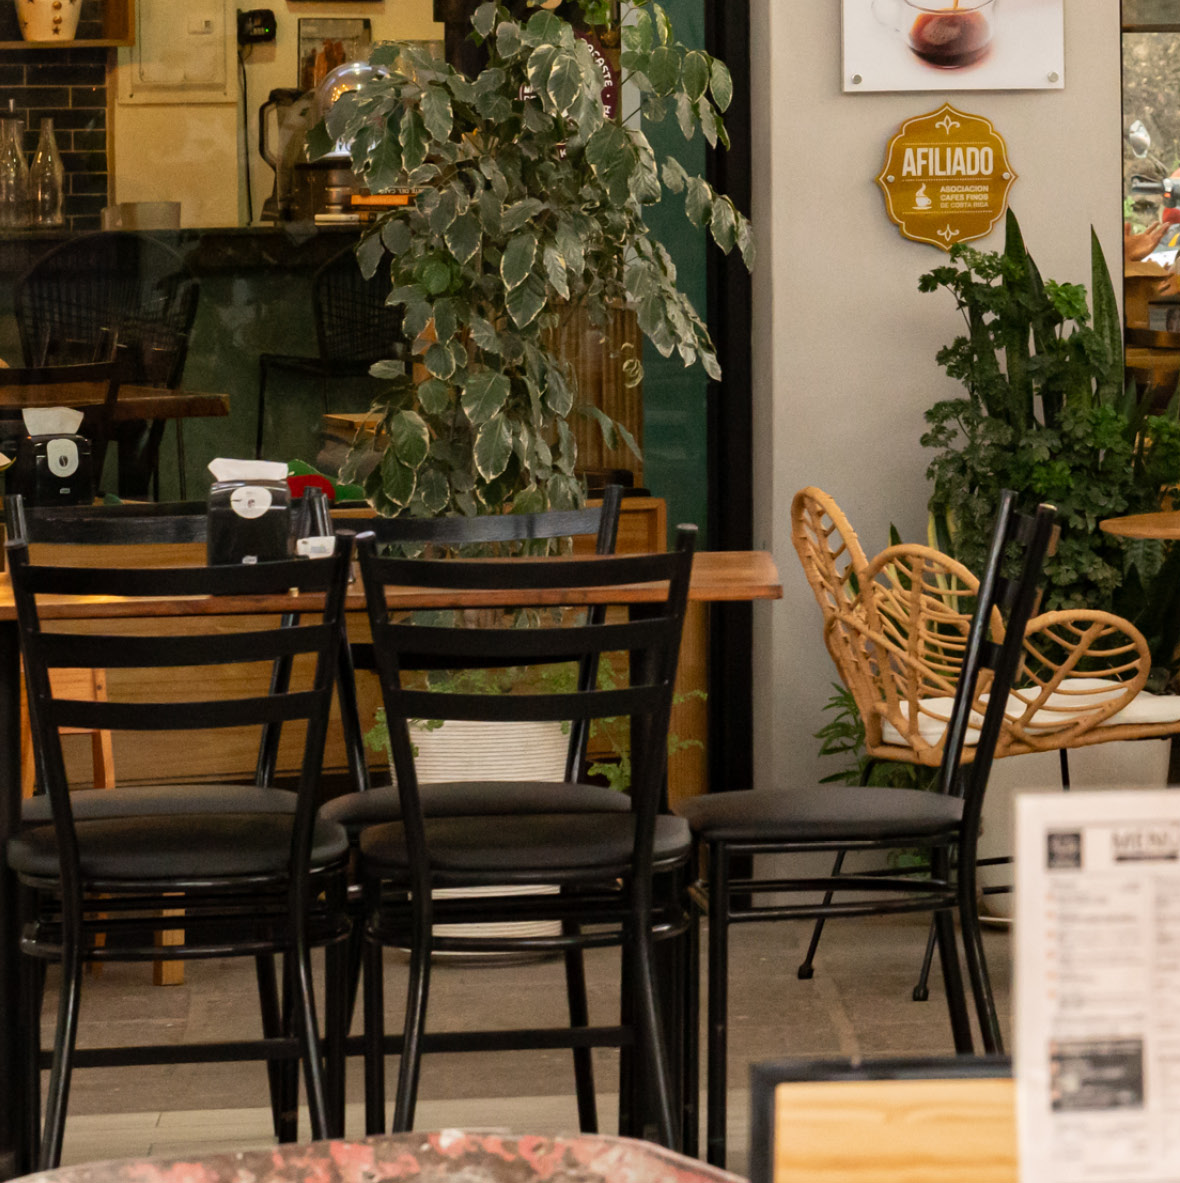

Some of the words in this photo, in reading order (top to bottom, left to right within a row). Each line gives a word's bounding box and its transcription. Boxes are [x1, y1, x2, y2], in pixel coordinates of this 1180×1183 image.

[902, 146, 994, 177] AFILIADO
[940, 185, 989, 193] ASOCIACION
[940, 194, 965, 202] CAFES
[966, 193, 989, 201] FINOS
